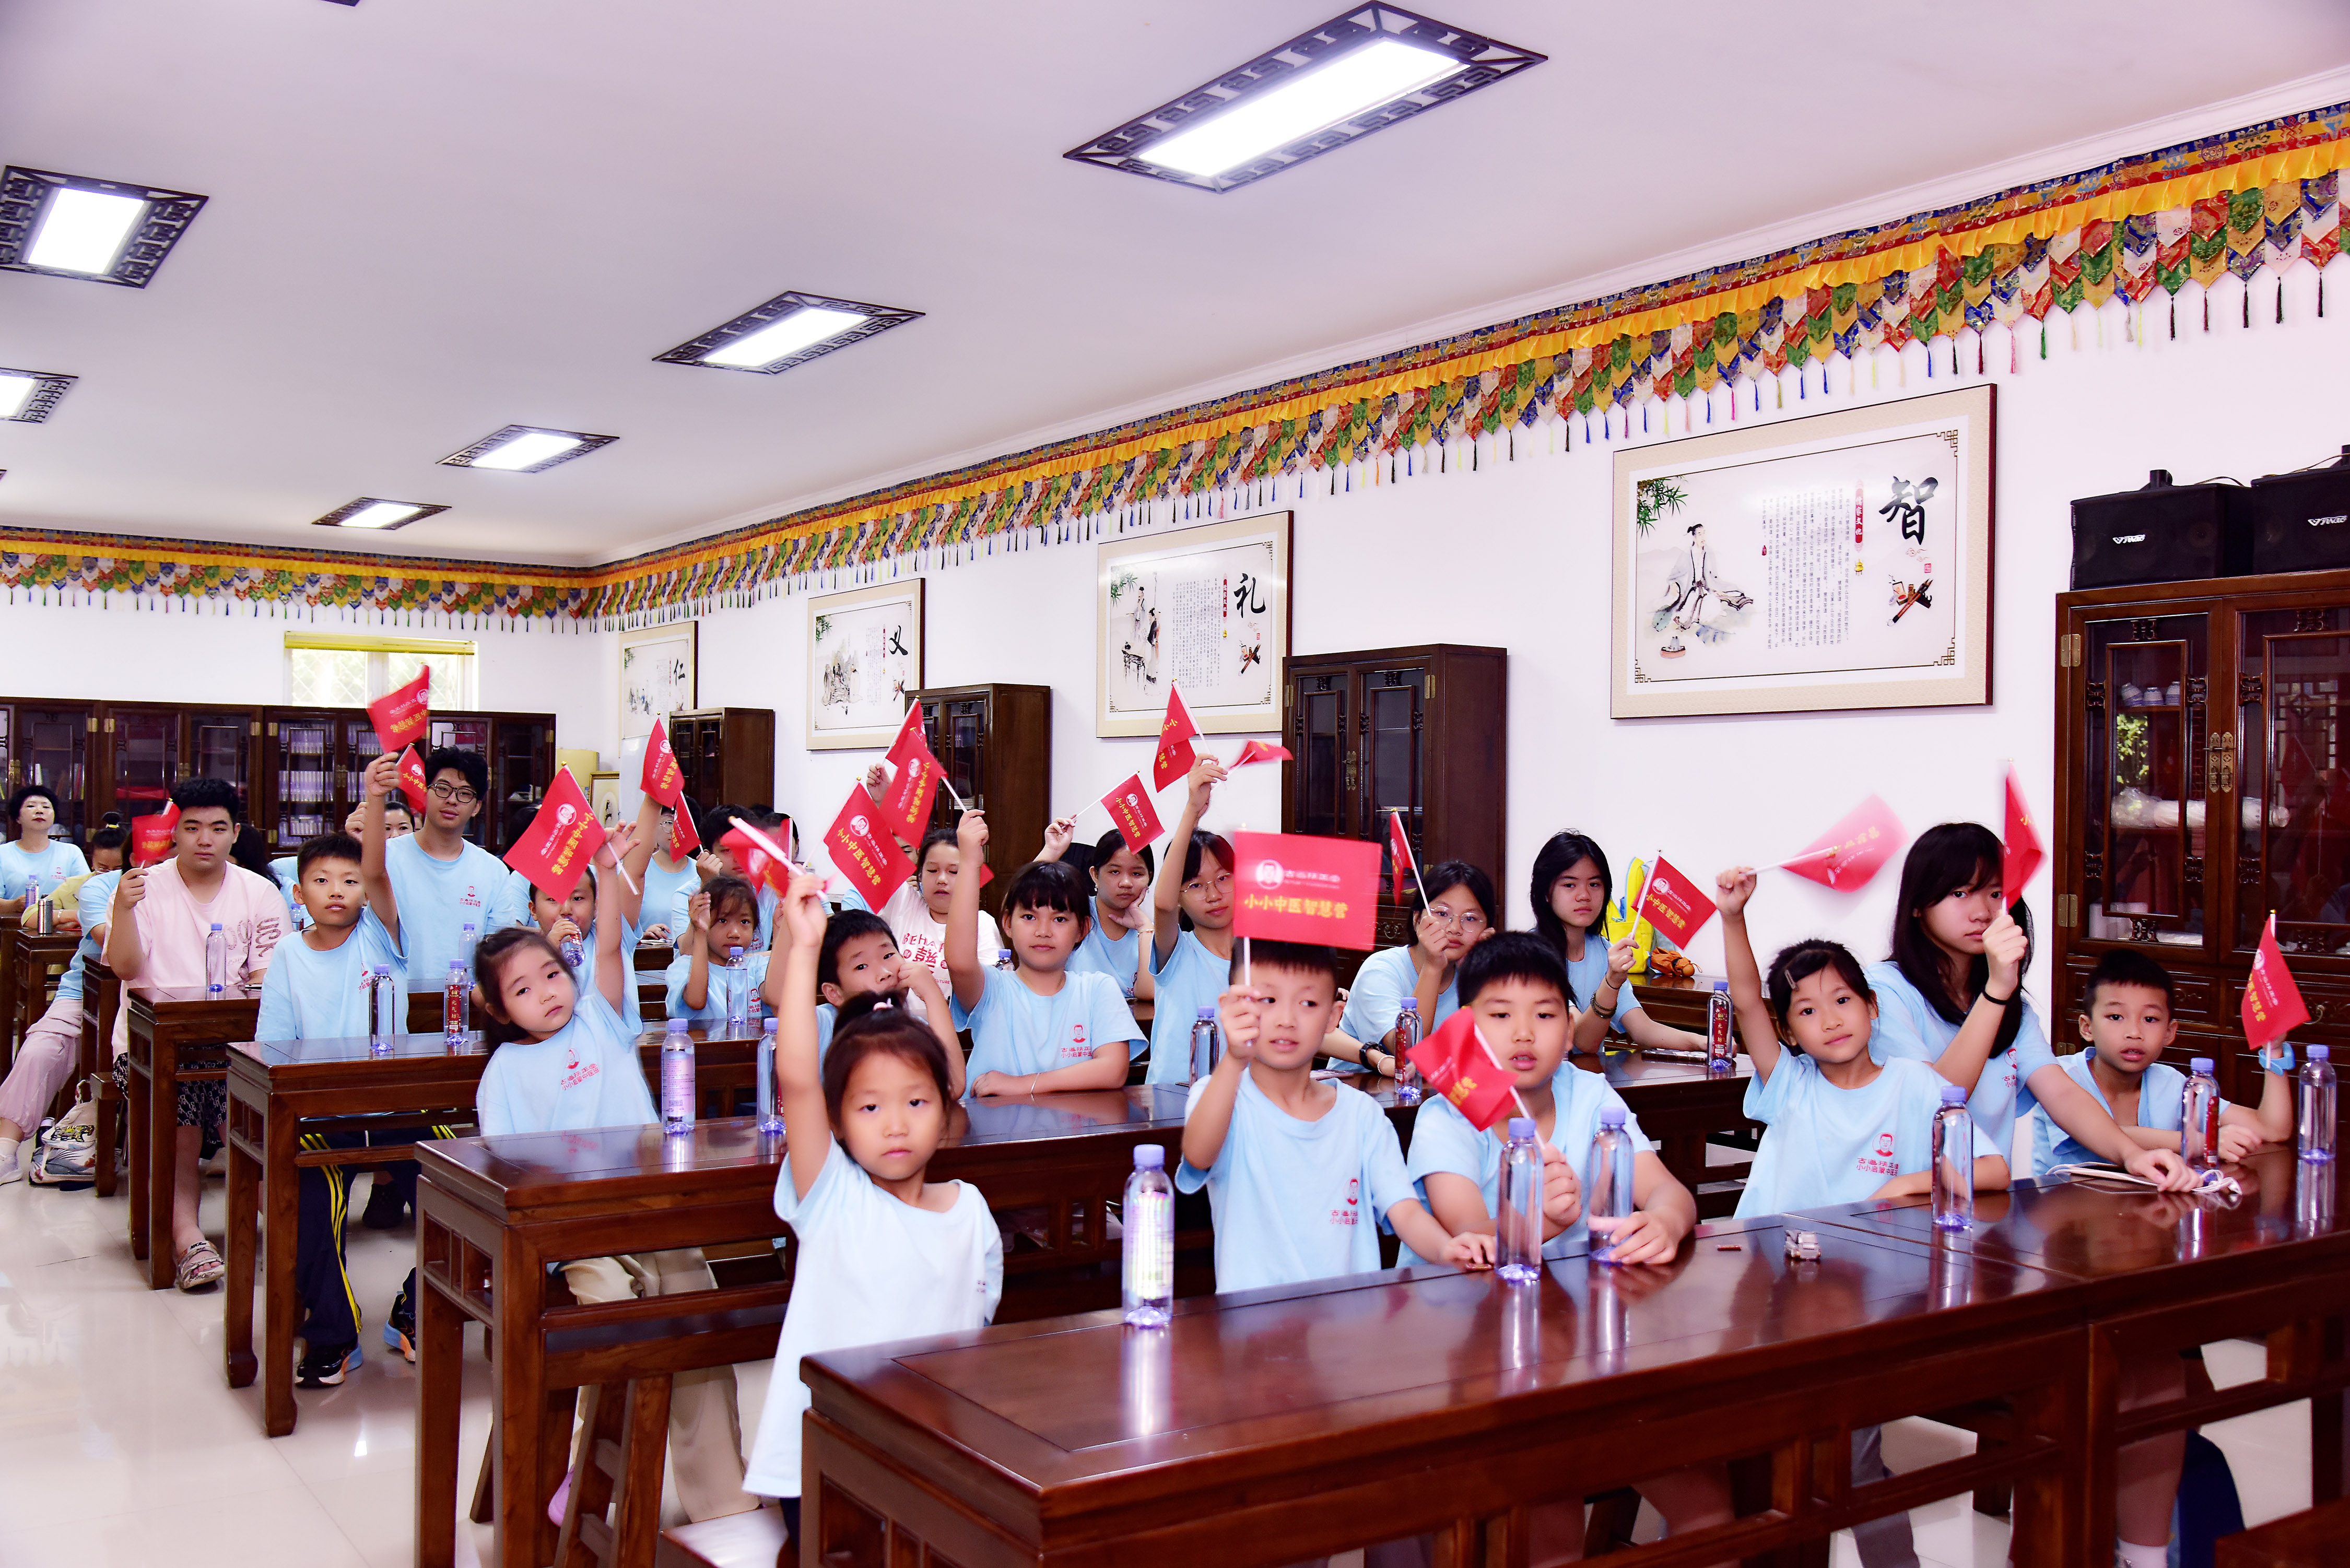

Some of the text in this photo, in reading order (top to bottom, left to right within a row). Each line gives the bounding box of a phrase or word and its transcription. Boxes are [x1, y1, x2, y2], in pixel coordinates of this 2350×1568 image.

[1879, 476, 1938, 545] 智
[1234, 573, 1266, 618] 礼
[888, 625, 908, 655] 义
[674, 658, 685, 687] 仁
[1116, 797, 1141, 838] 小小中医智慧营
[838, 828, 882, 886] 小小中医智慧营
[1244, 893, 1348, 919] 小小中医智慧营
